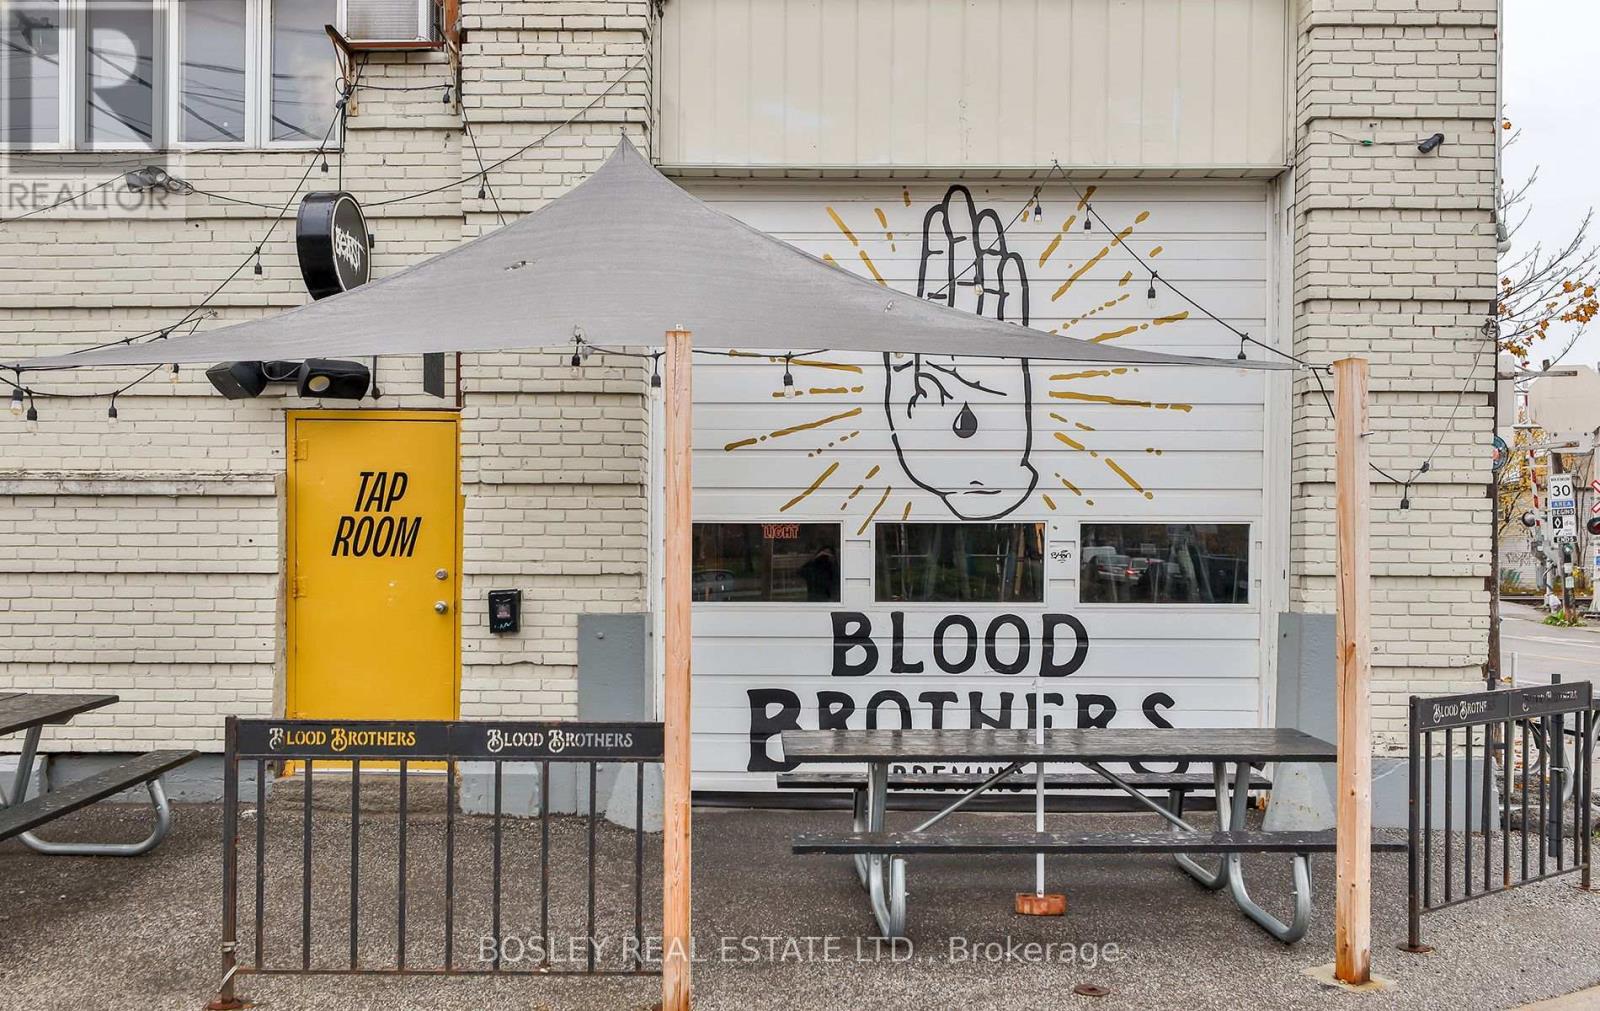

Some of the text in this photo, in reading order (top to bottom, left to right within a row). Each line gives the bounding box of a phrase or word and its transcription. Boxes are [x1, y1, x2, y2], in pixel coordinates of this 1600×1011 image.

[354, 471, 408, 513] TAP
[1552, 484, 1571, 497] 30
[331, 515, 422, 558] ROOM
[763, 525, 799, 539] LIGHT
[830, 611, 1089, 677] BLOOD
[330, 727, 416, 752] BROTHERS
[486, 729, 633, 753] BLOOD BROTHERS
